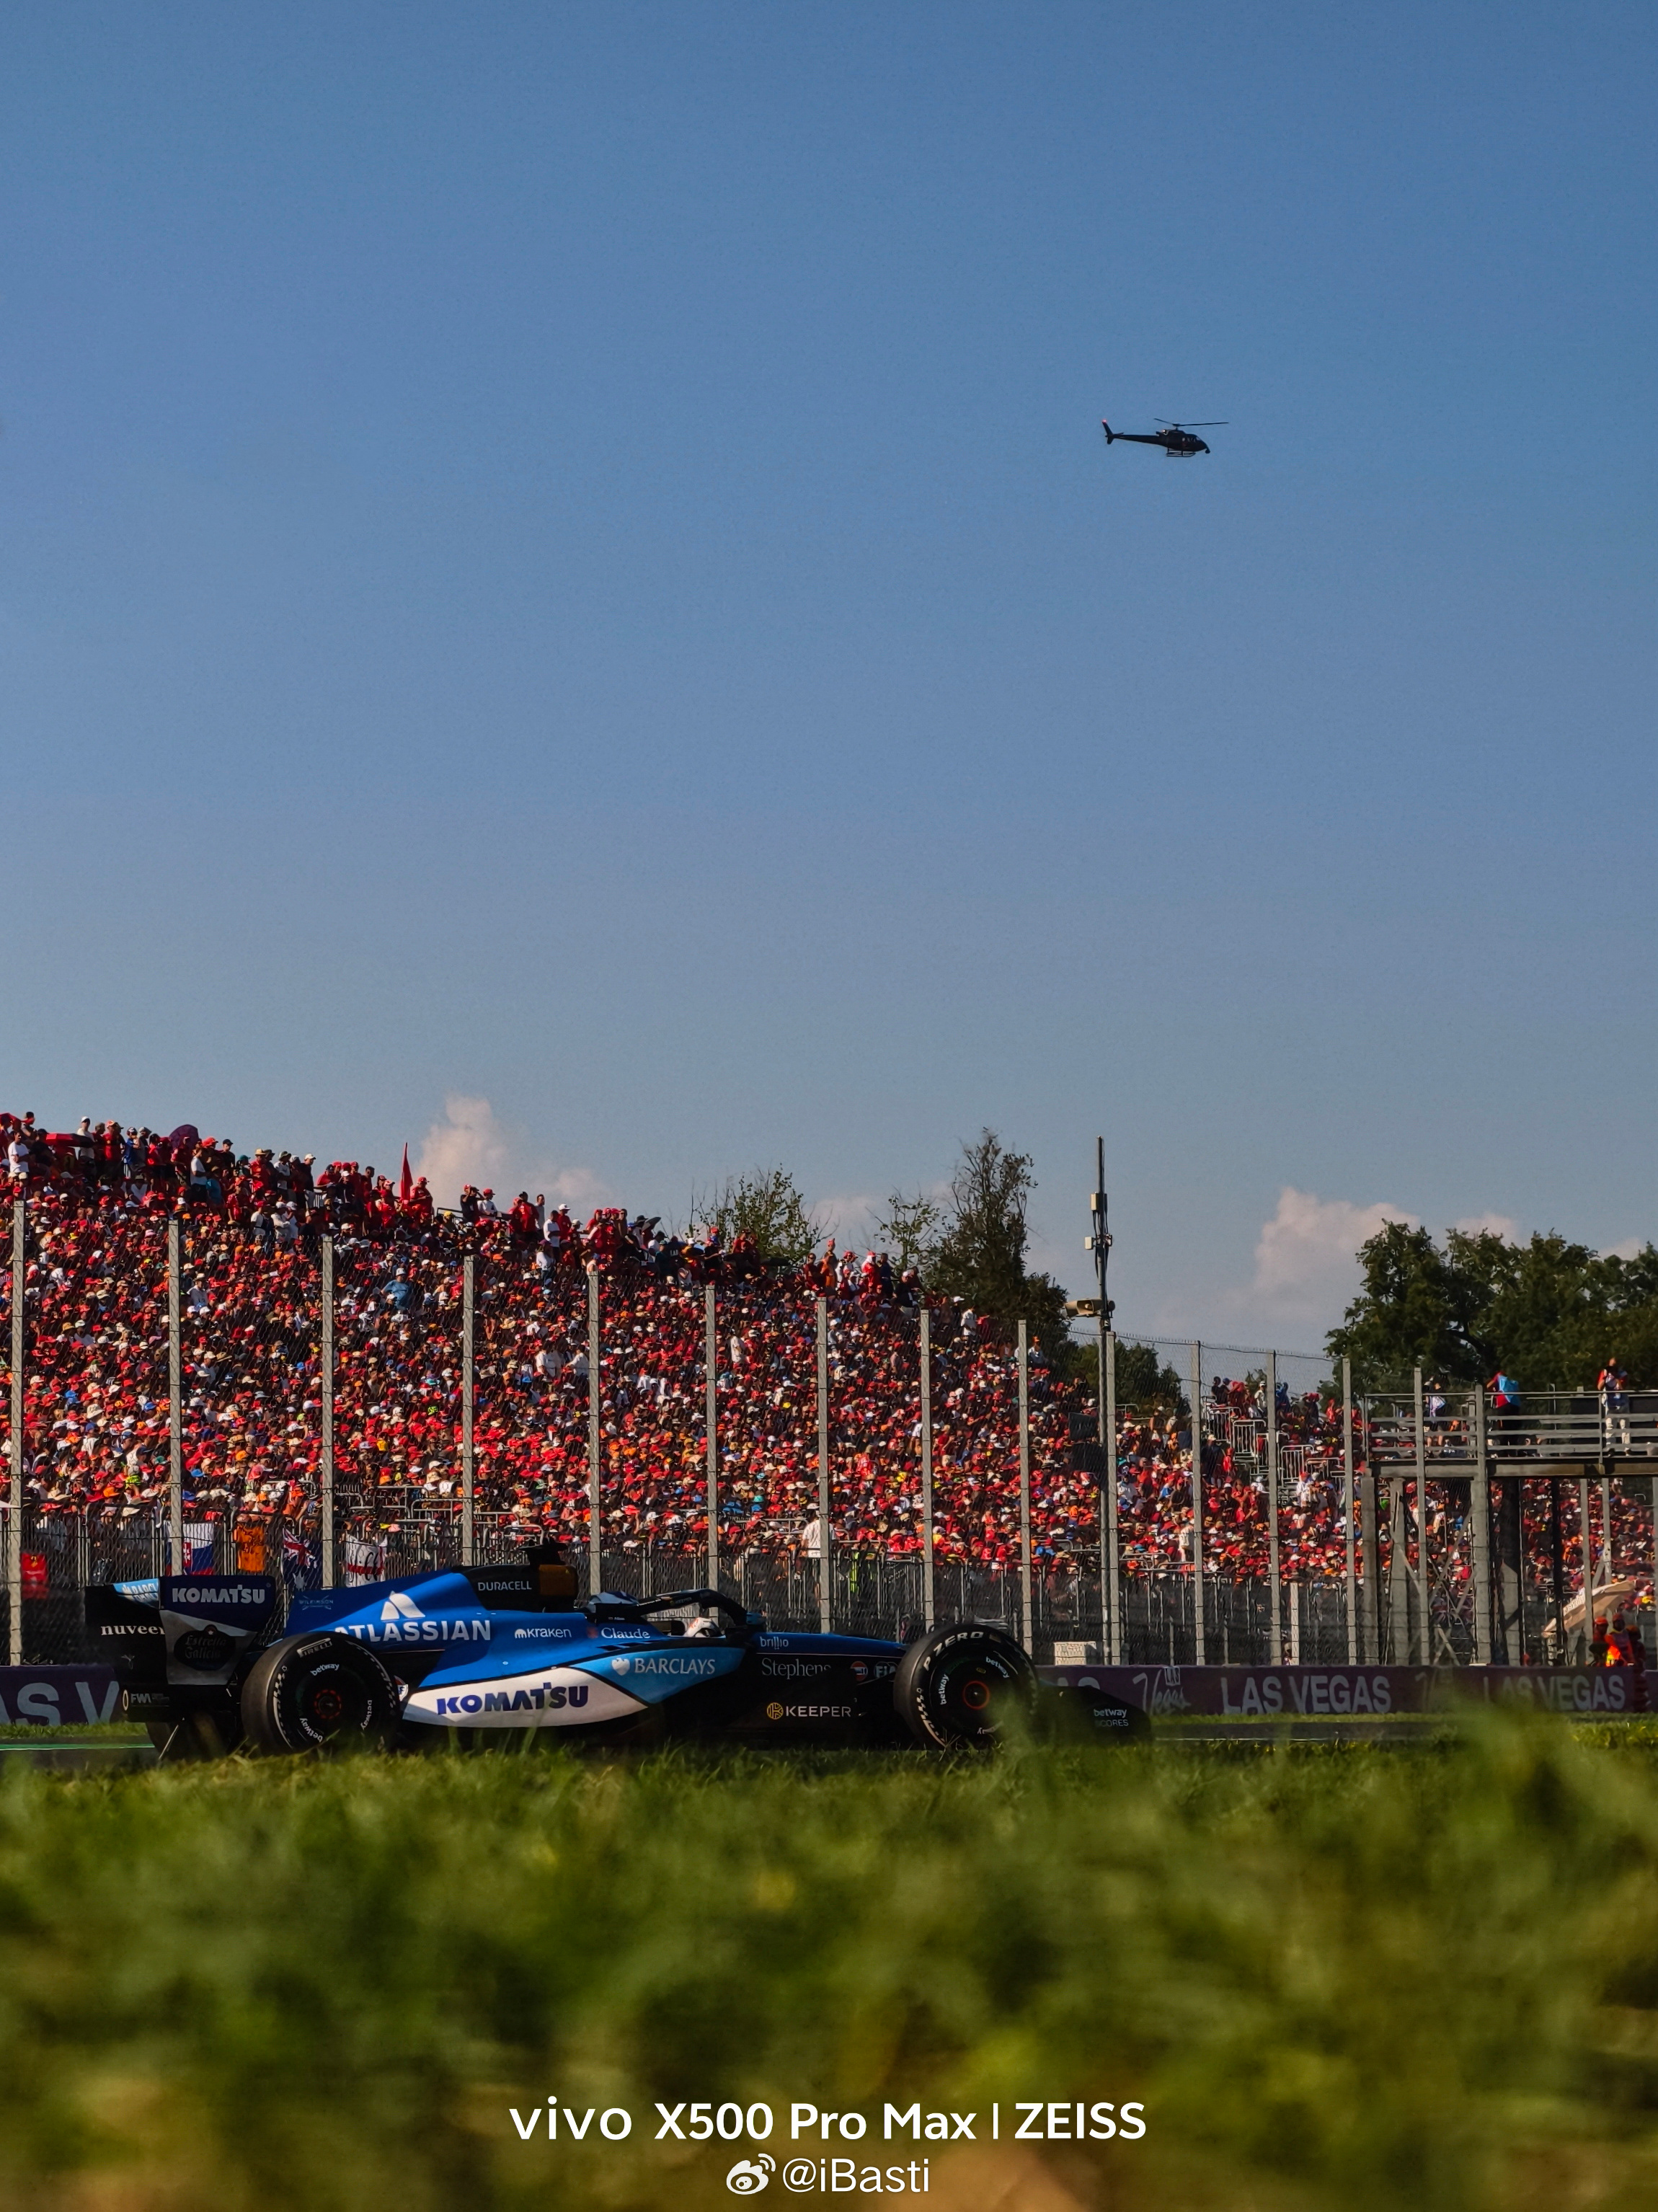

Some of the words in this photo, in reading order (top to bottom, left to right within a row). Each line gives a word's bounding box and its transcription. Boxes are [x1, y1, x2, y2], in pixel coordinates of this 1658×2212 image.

[172, 1584, 265, 1604] KOMATSU
[478, 1581, 532, 1591] DURACELL
[600, 1627, 650, 1640] Claude
[759, 1635, 789, 1650] brillio
[933, 1631, 985, 1658] ZERO
[310, 1663, 340, 1676] betway
[634, 1658, 716, 1675] BARCLAYS
[985, 1655, 1010, 1678] betway
[436, 1681, 589, 1715] KOMATSU
[939, 1673, 951, 1706] betway
[1221, 1676, 1284, 1714] LAS
[1287, 1674, 1393, 1715] VEGAS
[1537, 1674, 1627, 1712] VEGAS
[360, 1699, 373, 1730] betway
[786, 1705, 851, 1718] KEEPER
[1093, 1709, 1127, 1719] betway
[299, 1717, 324, 1743] betway
